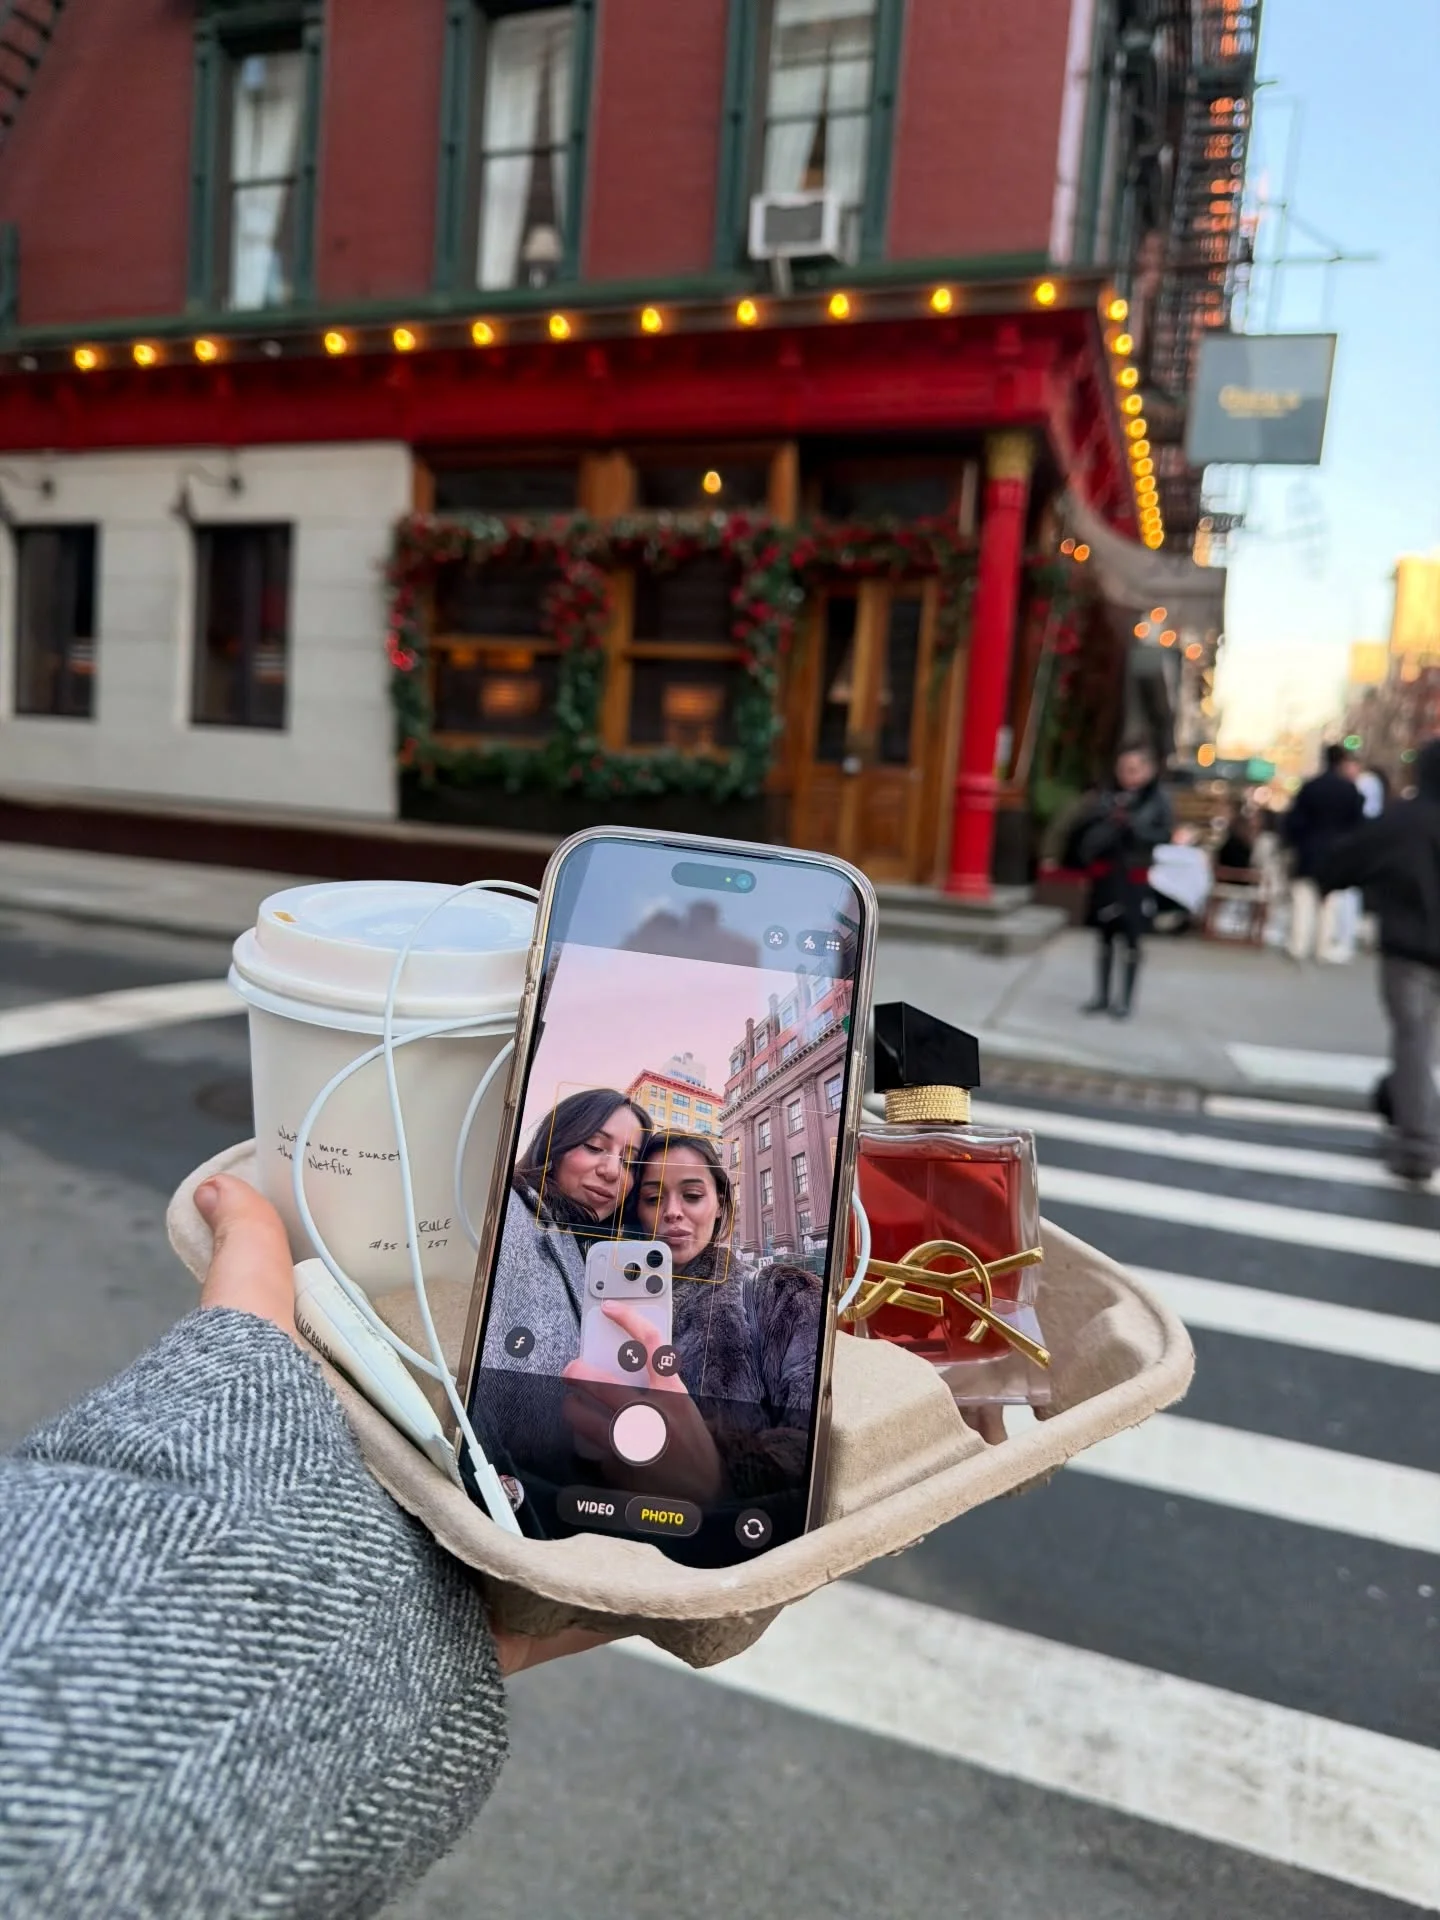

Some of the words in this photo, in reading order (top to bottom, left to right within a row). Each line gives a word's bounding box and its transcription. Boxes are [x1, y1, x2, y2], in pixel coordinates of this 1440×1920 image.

[319, 1143, 349, 1156] more
[308, 1155, 352, 1176] Netflix
[418, 1217, 452, 1233] RULE
[576, 1500, 615, 1516] VIDEO
[641, 1508, 684, 1525] PHOTO
